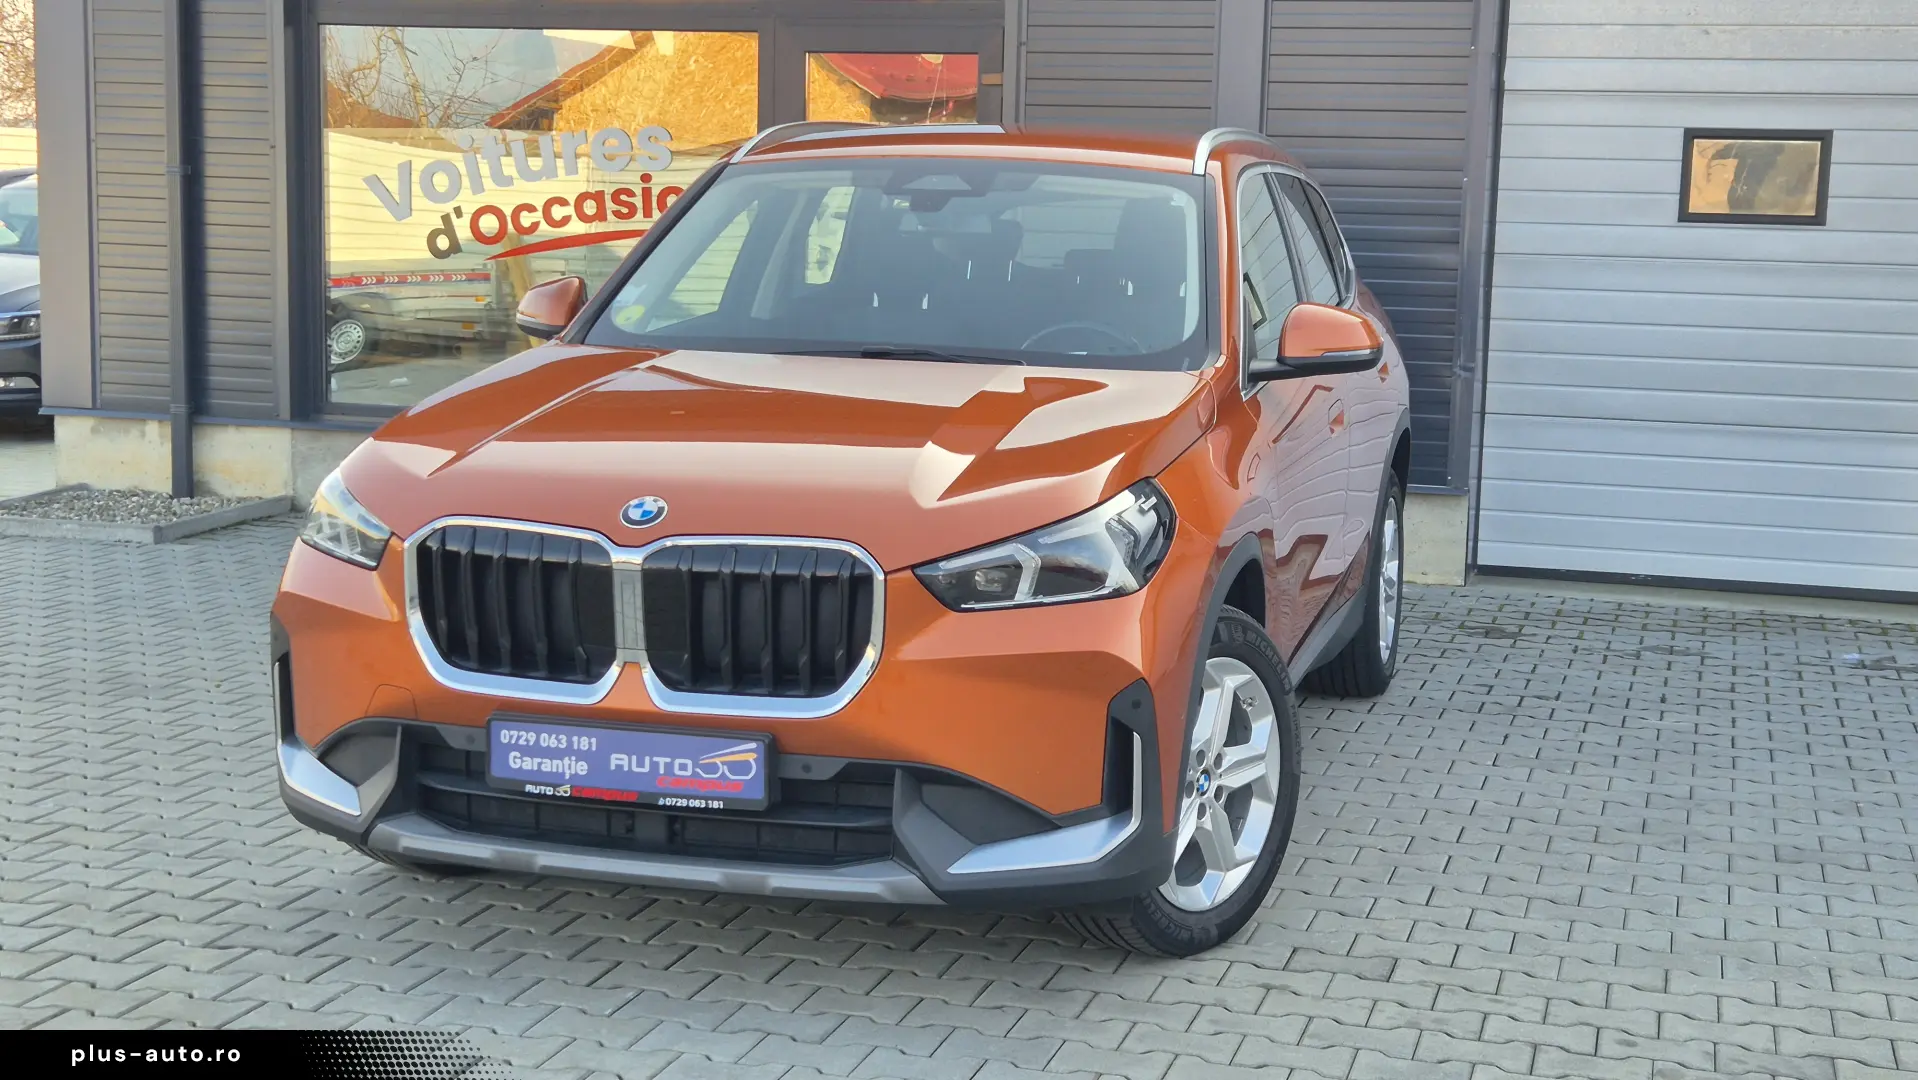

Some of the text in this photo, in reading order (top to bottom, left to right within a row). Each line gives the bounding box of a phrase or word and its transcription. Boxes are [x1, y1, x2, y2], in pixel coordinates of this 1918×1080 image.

[362, 125, 673, 222] Voitures
[1244, 629, 1292, 693] MICHELIN
[500, 729, 597, 751] 0729 063 181
[610, 753, 693, 776] AUTO
[525, 784, 554, 796] AUTO
[665, 798, 724, 809] 0729 063 181
